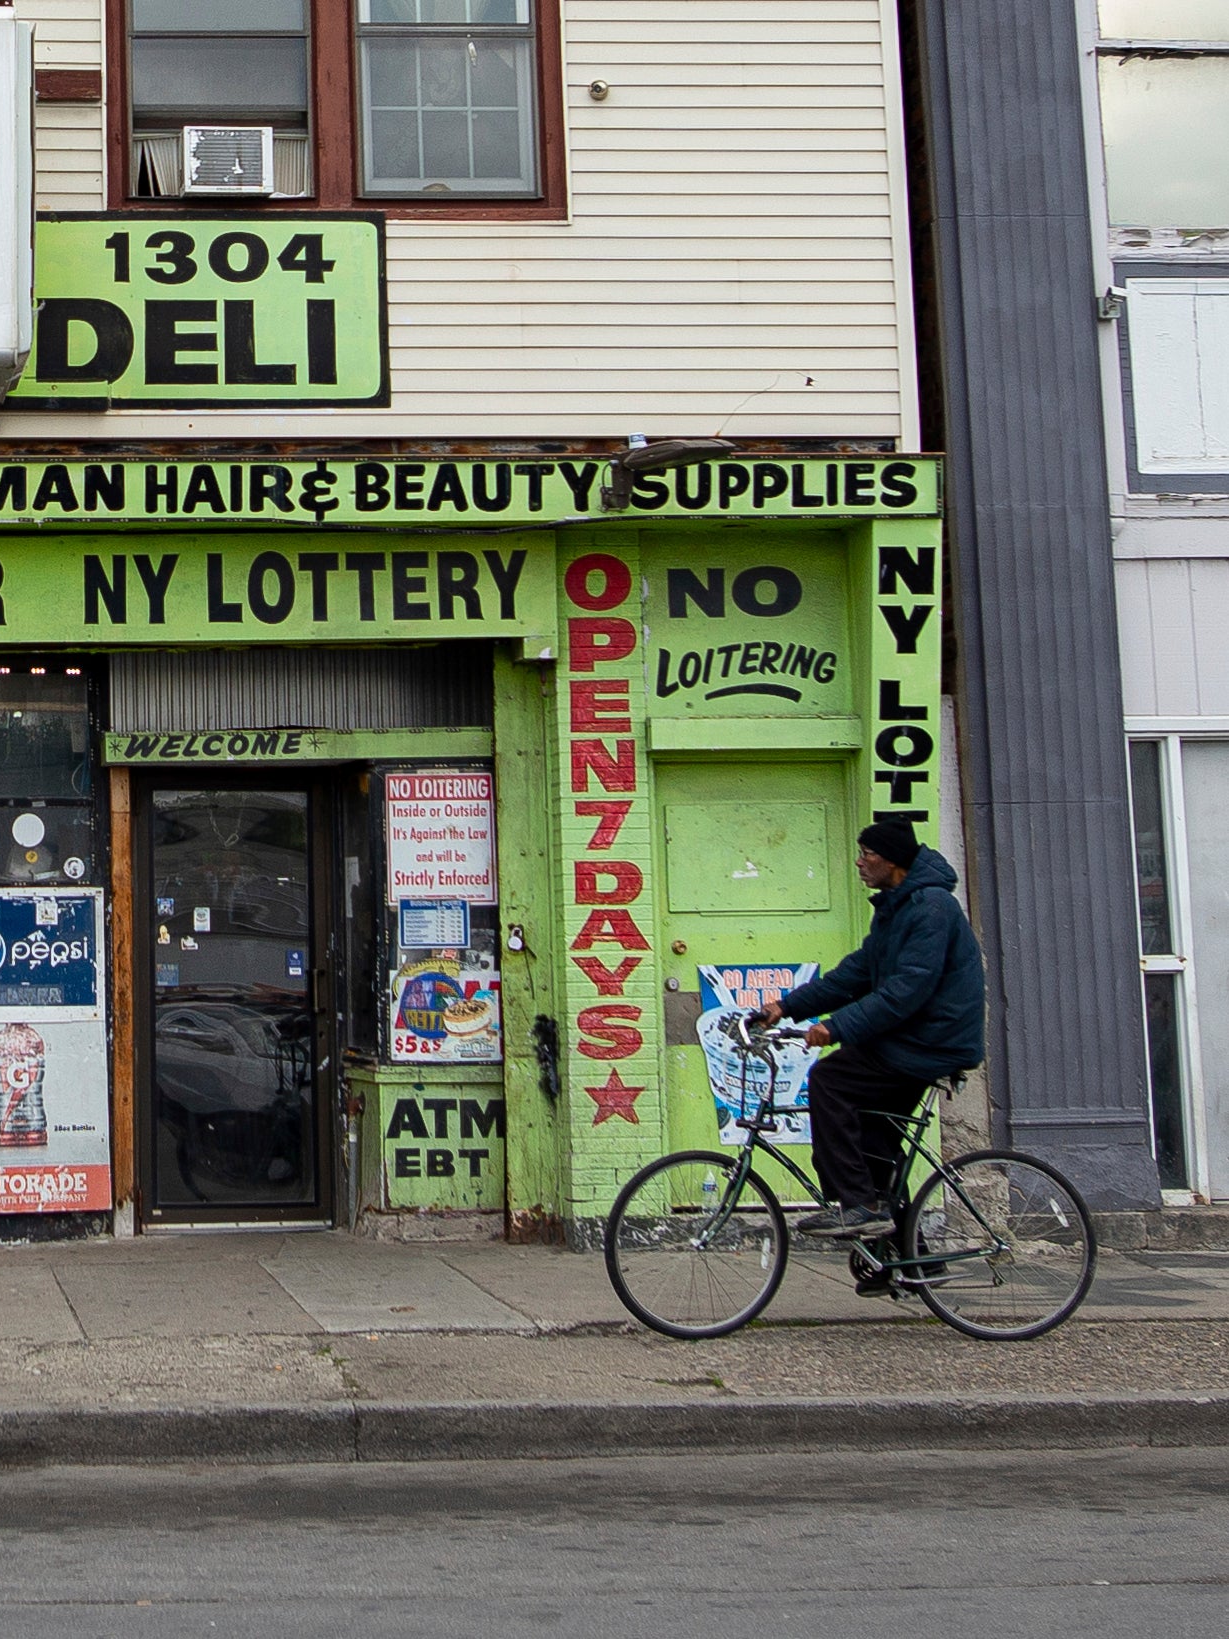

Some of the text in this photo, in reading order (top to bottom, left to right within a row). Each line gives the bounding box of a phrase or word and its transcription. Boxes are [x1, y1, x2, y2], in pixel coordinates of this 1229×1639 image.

[105, 230, 336, 284] 1304
[36, 298, 338, 385] DELI
[144, 463, 295, 513] HAIR
[298, 460, 340, 521] &
[355, 463, 599, 512] BEAUTY
[629, 462, 918, 510] SUPPLIES
[83, 553, 180, 625] NY
[206, 549, 528, 625] LOTTERY
[666, 565, 803, 619] NO
[877, 546, 937, 654] NY
[655, 640, 838, 699] LOITERING
[123, 732, 302, 759] WELCOME
[389, 778, 489, 799] NO LOITERING
[392, 803, 488, 818] Inside or Outside
[564, 553, 652, 1061] OPEN 7 DAYS
[392, 826, 488, 844] It's Against the Law
[415, 849, 467, 863] and will be
[394, 868, 490, 890] Strictly Enforced
[11, 936, 88, 968] pepsi
[723, 968, 794, 990] GO AHEAD
[735, 988, 761, 1009] DIG
[394, 1035, 418, 1054] $5
[5, 1062, 30, 1089] G
[386, 1097, 506, 1139] ATM
[394, 1147, 490, 1178] EBT
